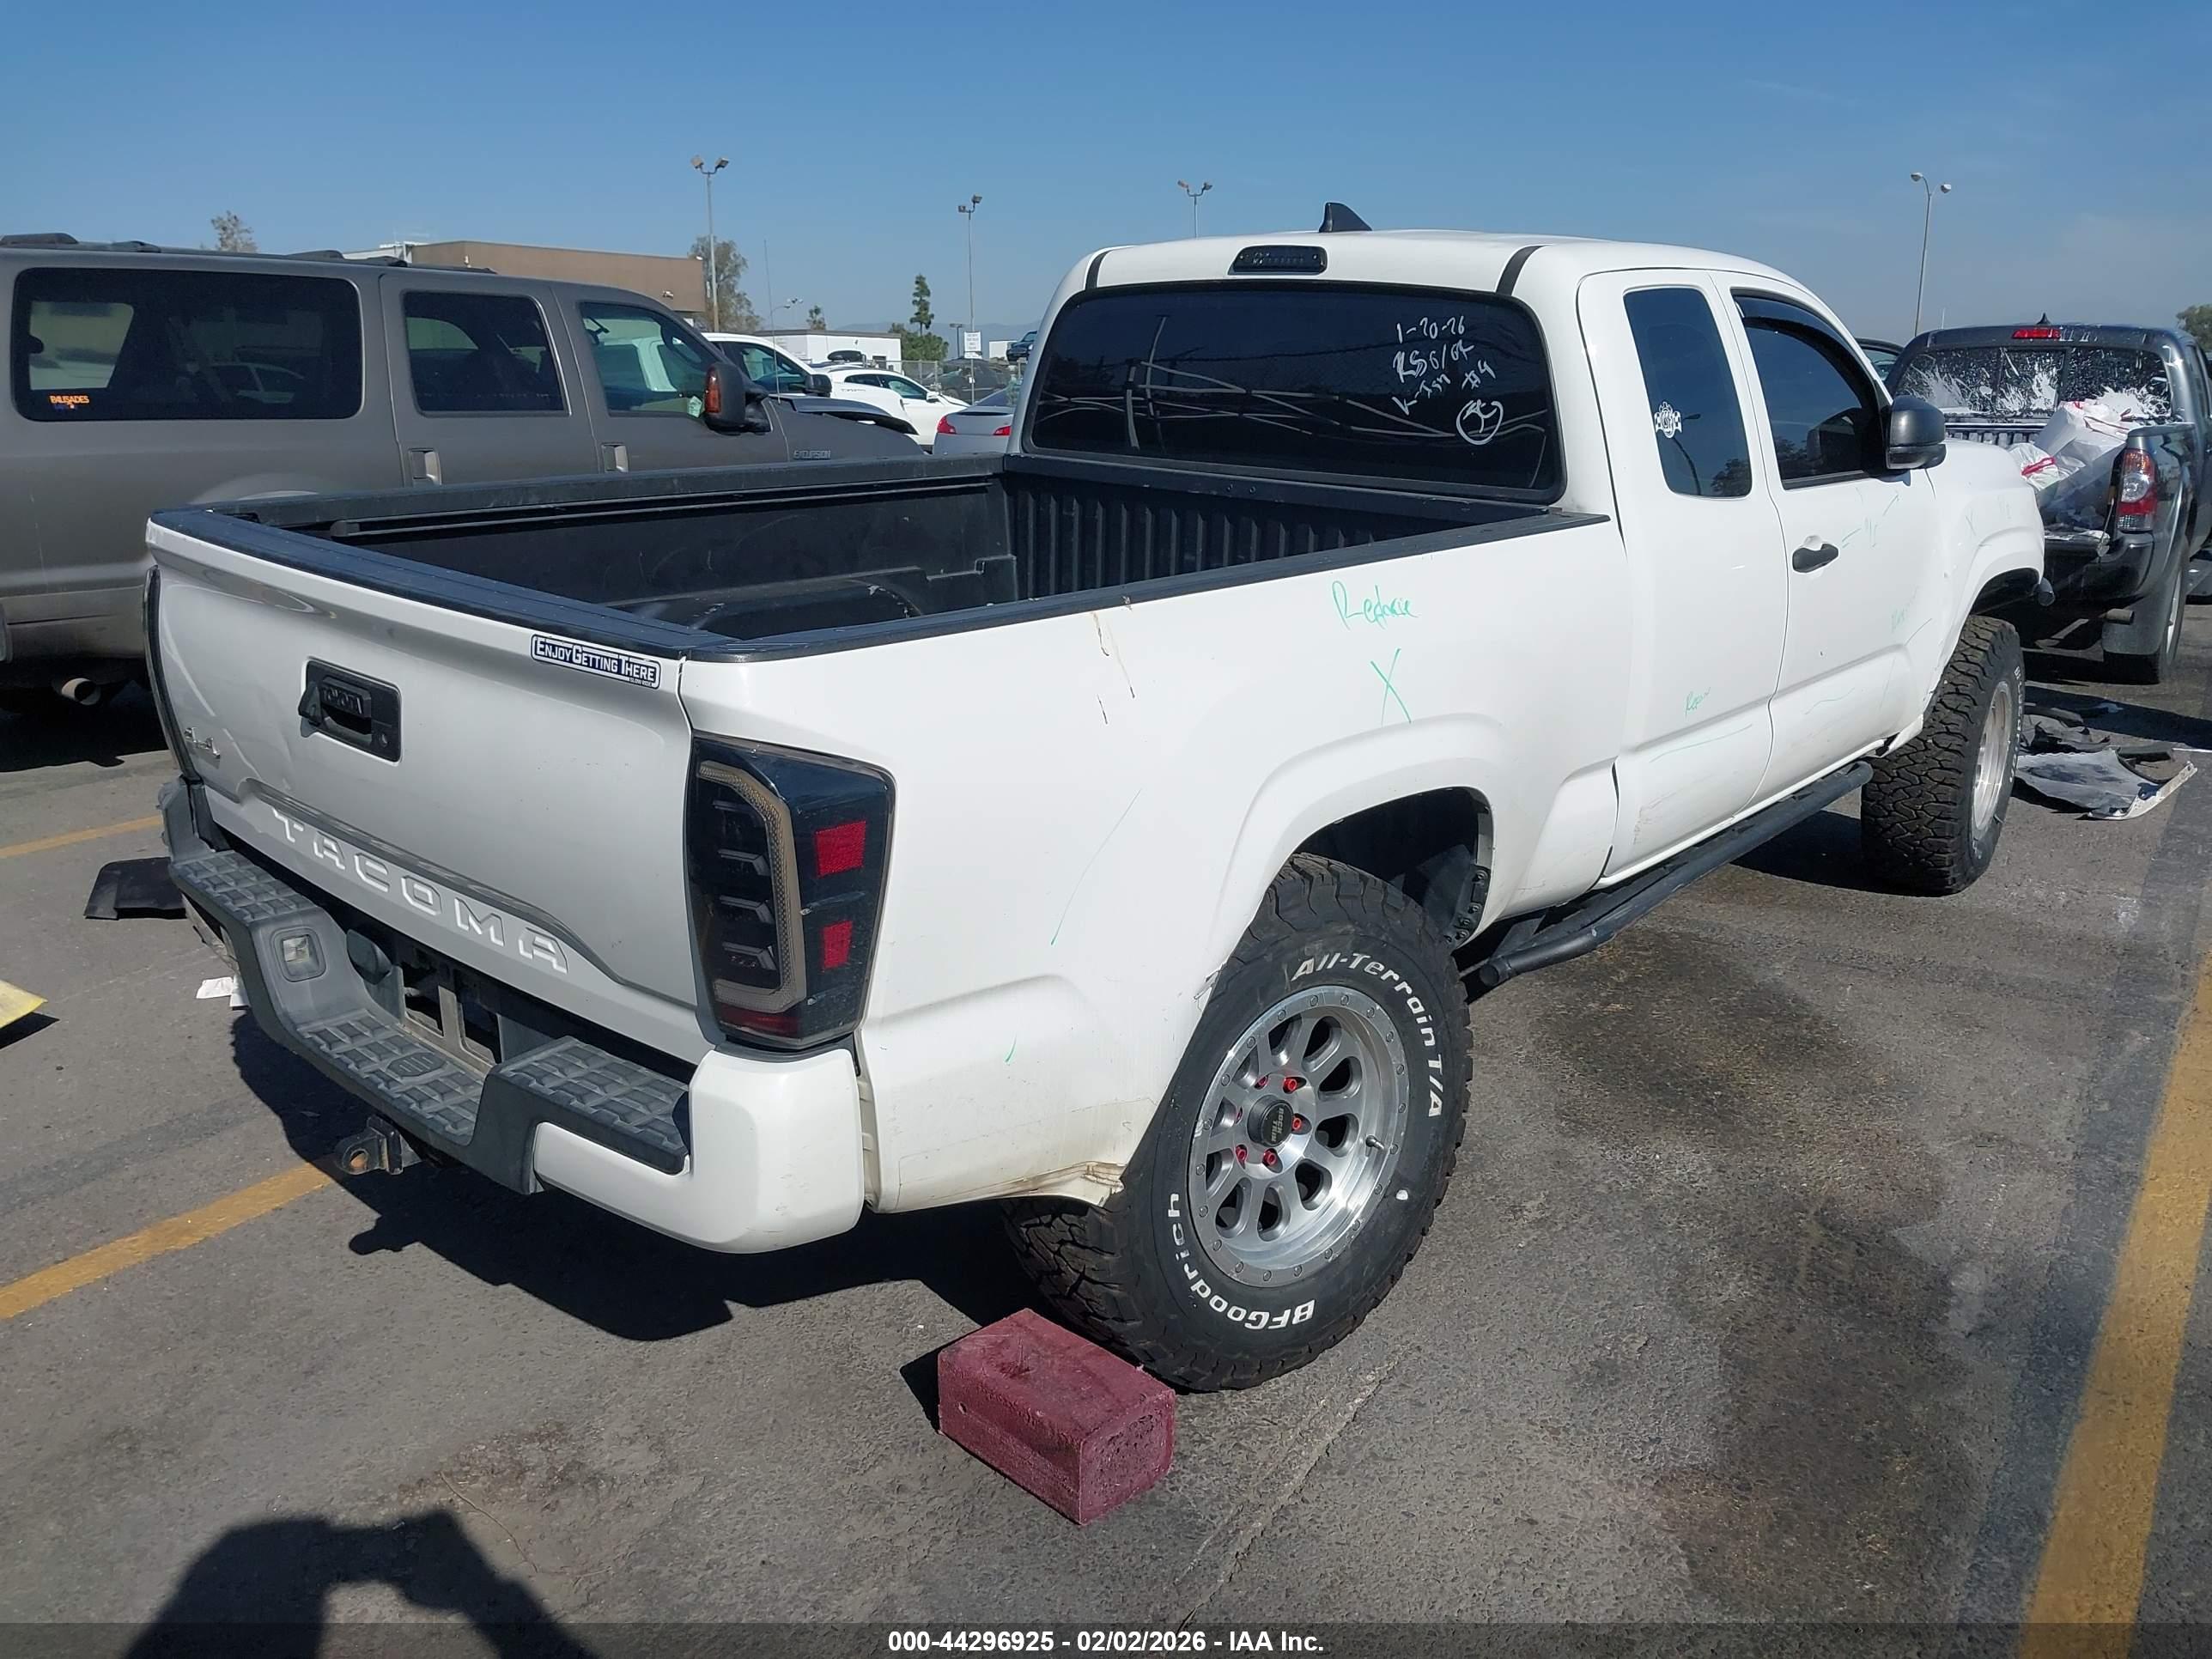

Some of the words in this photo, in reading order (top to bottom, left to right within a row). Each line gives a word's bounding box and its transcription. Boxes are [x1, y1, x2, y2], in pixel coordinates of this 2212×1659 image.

[536, 637, 573, 661] ENJOY
[572, 645, 618, 672] GETTING
[618, 655, 655, 681] THERE
[271, 805, 569, 975] TACOMA
[1291, 951, 1437, 1048] All-Terrain
[1427, 1053, 1444, 1118] T/A
[1167, 1193, 1316, 1331] BFGoodrich
